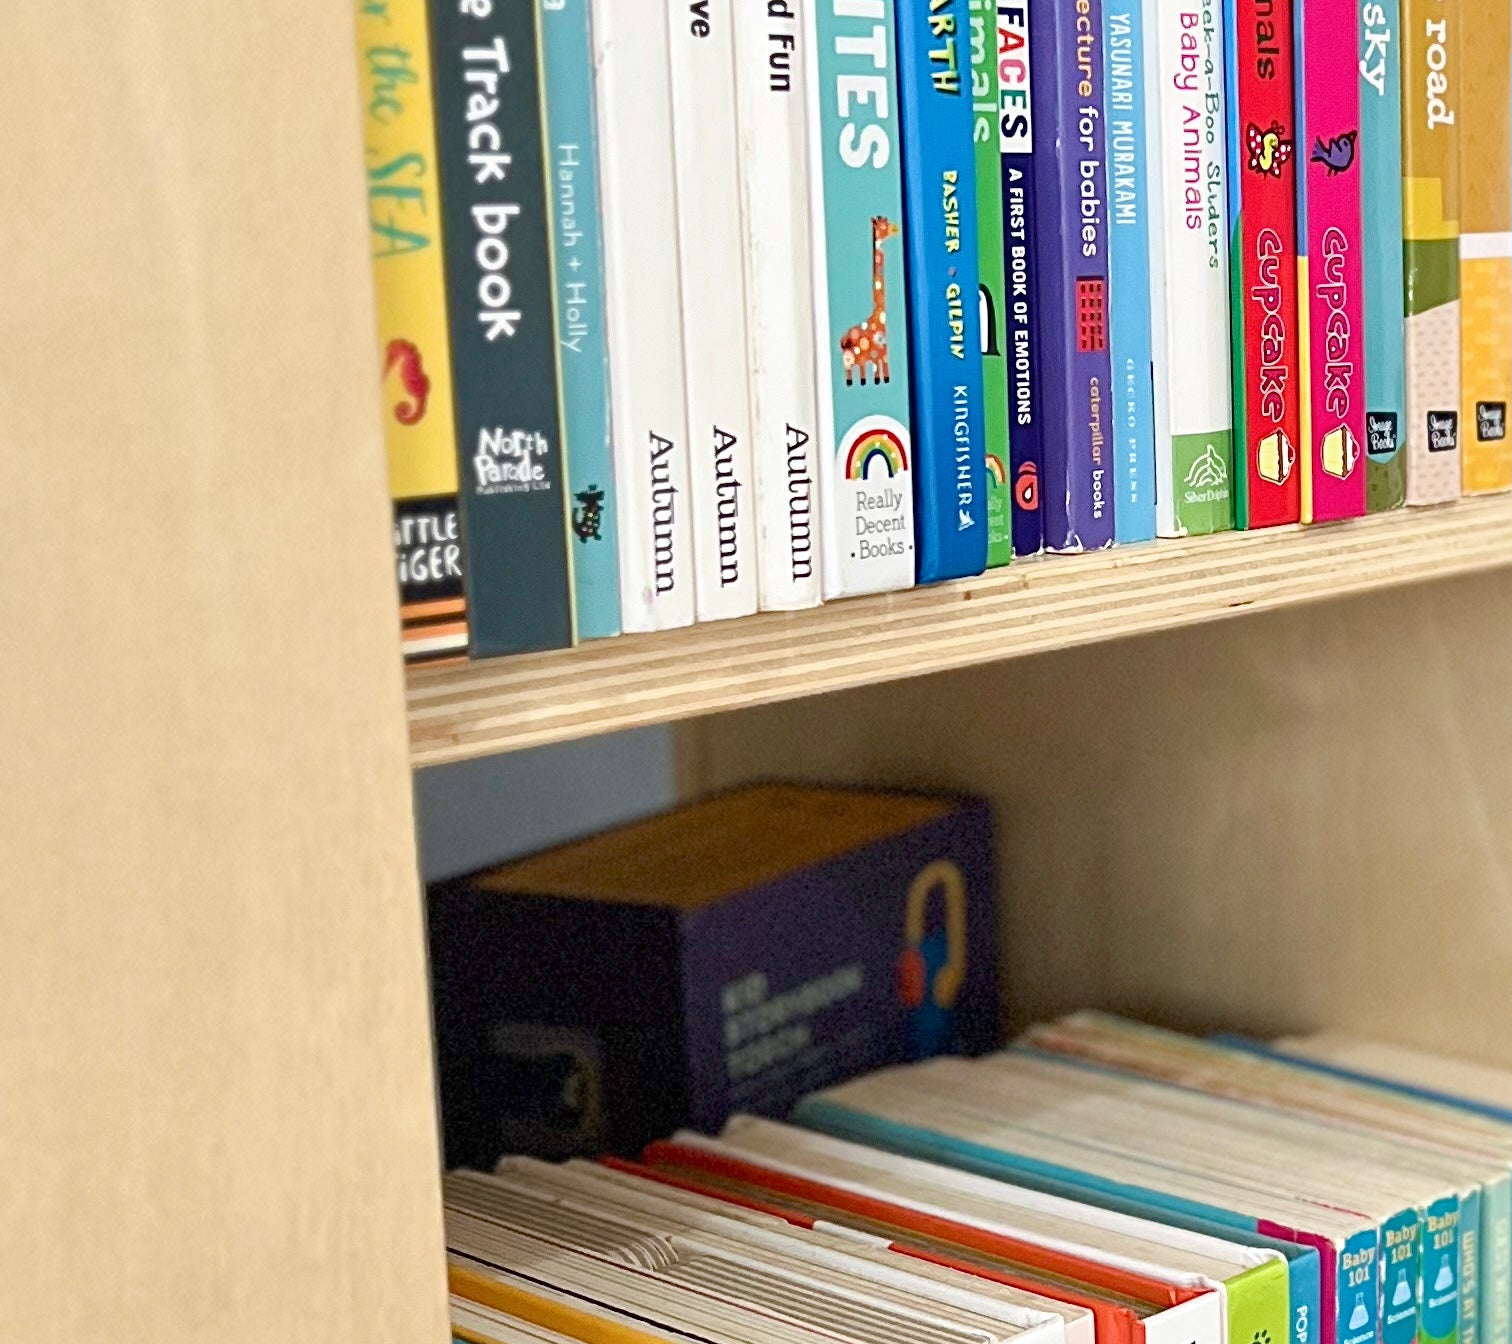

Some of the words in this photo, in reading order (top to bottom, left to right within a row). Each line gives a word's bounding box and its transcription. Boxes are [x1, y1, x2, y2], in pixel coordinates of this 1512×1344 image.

[366, 45, 418, 124] the
[768, 32, 795, 93] Fun
[995, 6, 1028, 139] FACES
[1110, 13, 1133, 104] YASUNARI
[1174, 12, 1200, 91] Baby
[1359, 2, 1391, 96] sky
[1426, 19, 1455, 130] road
[461, 37, 511, 185] Track
[1078, 106, 1099, 152] for
[367, 152, 430, 257] SEA
[558, 144, 582, 248] Hannah
[1009, 187, 1025, 240] FIRST
[1010, 168, 1021, 181] A
[1079, 159, 1101, 258] babies
[1115, 120, 1137, 225] MURAKAMI
[1182, 105, 1202, 230] Animals
[1205, 160, 1220, 270] Sliders
[470, 204, 522, 342] book
[561, 283, 588, 353] Holly
[1011, 244, 1026, 296] BOOK
[1014, 301, 1027, 322] OF
[1251, 227, 1289, 423] Cupcake
[1317, 226, 1352, 418] Cupcake
[1014, 326, 1031, 425] EMOTIONS
[1089, 376, 1103, 465] caterpillar
[953, 384, 975, 507] KINGFISHER
[1091, 470, 1103, 519] books
[649, 429, 680, 597] Autumn
[713, 425, 742, 588] Autumn
[785, 423, 813, 583] Autumn
[856, 489, 904, 513] Really
[856, 515, 906, 536] Decent
[859, 538, 905, 561] Books
